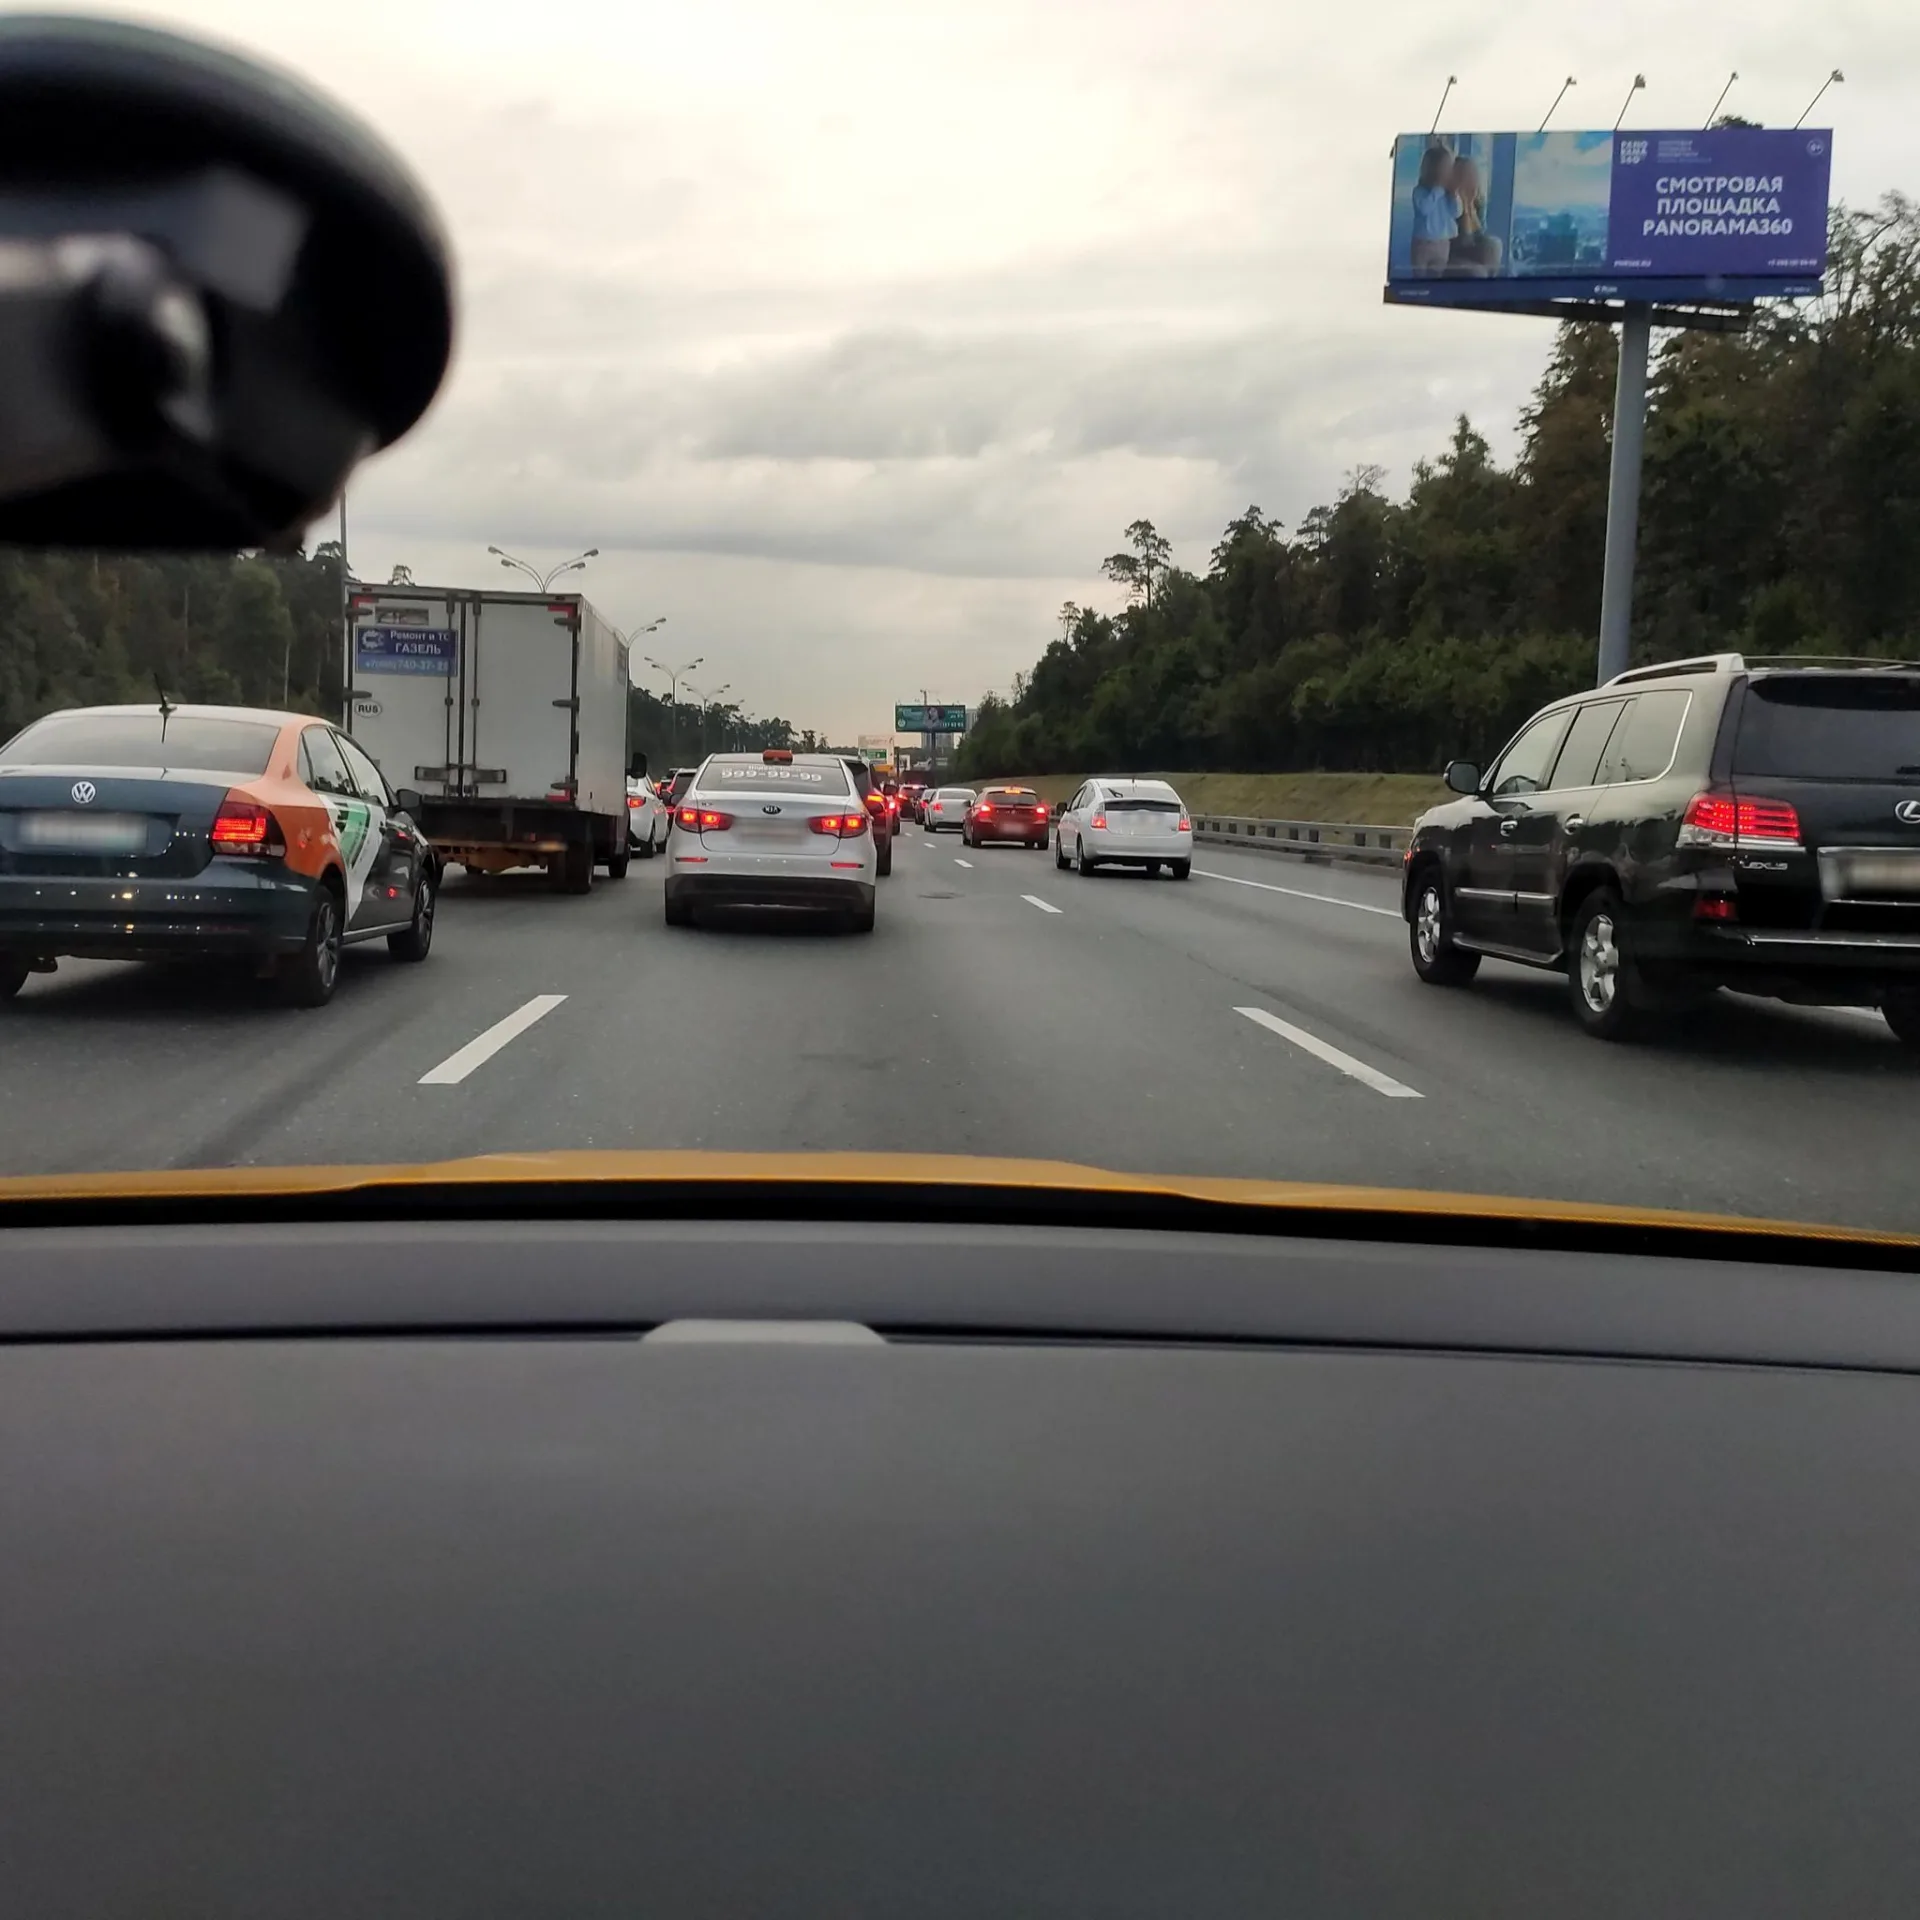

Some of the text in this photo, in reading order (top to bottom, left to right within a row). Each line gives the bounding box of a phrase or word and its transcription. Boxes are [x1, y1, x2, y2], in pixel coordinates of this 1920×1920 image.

[1656, 176, 1784, 194] СМОТРОВАЯ
[1656, 197, 1781, 216] ПЛОЩАДКА
[1642, 218, 1793, 236] PANORAMA360
[390, 630, 427, 641] Ремонт
[395, 642, 442, 655] ГАЗЕЛЬ
[358, 704, 379, 714] RUS
[721, 769, 823, 782] 999-99-99
[1739, 861, 1788, 870] LEXUS
